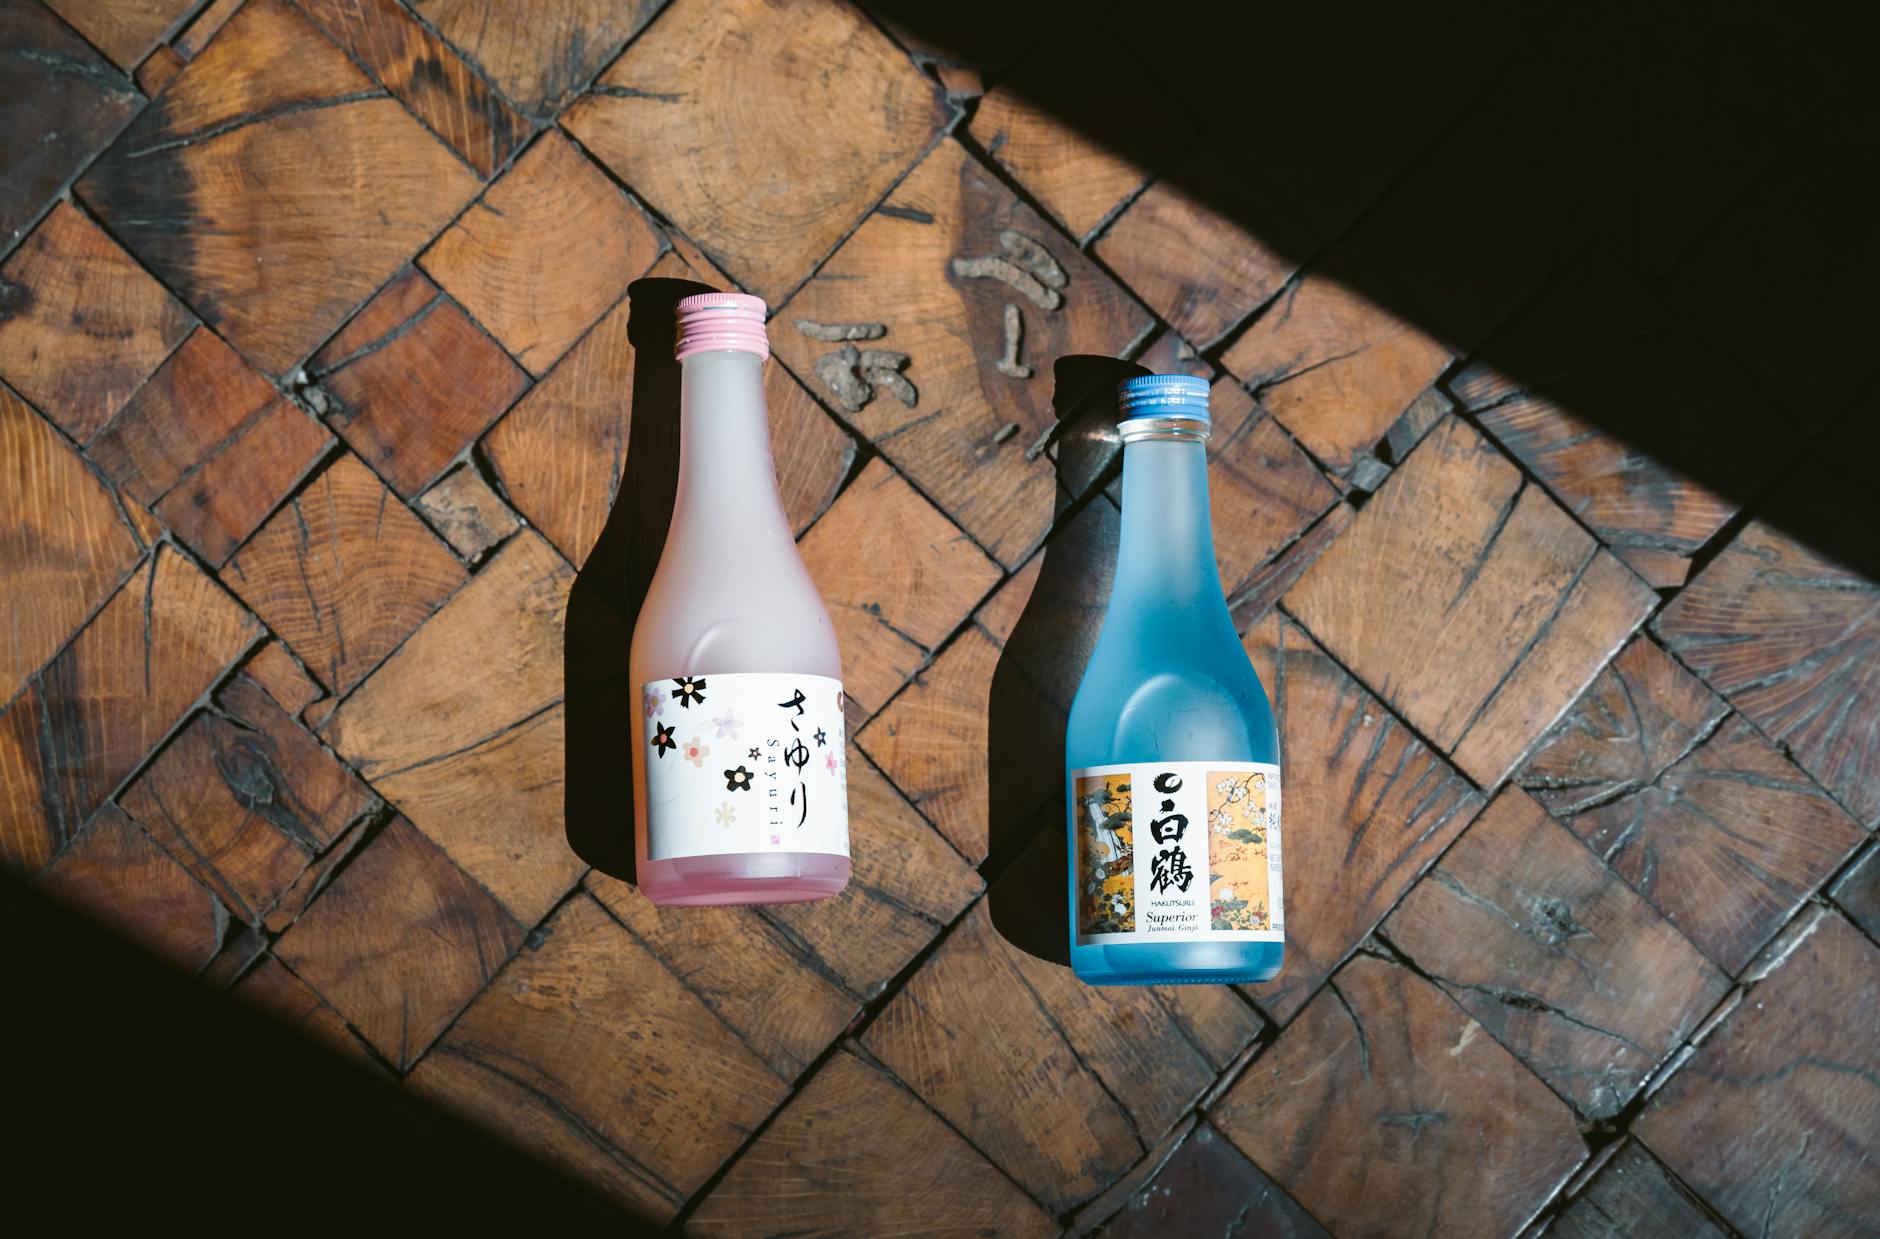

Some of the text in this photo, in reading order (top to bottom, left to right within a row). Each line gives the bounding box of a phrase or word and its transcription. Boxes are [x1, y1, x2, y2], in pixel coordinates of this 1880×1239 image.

[764, 738, 783, 825] Sayuri
[777, 688, 810, 828] さゆり
[1150, 798, 1194, 895] 白鶴
[1145, 911, 1199, 925] Superior
[1147, 924, 1175, 933] Junmai
